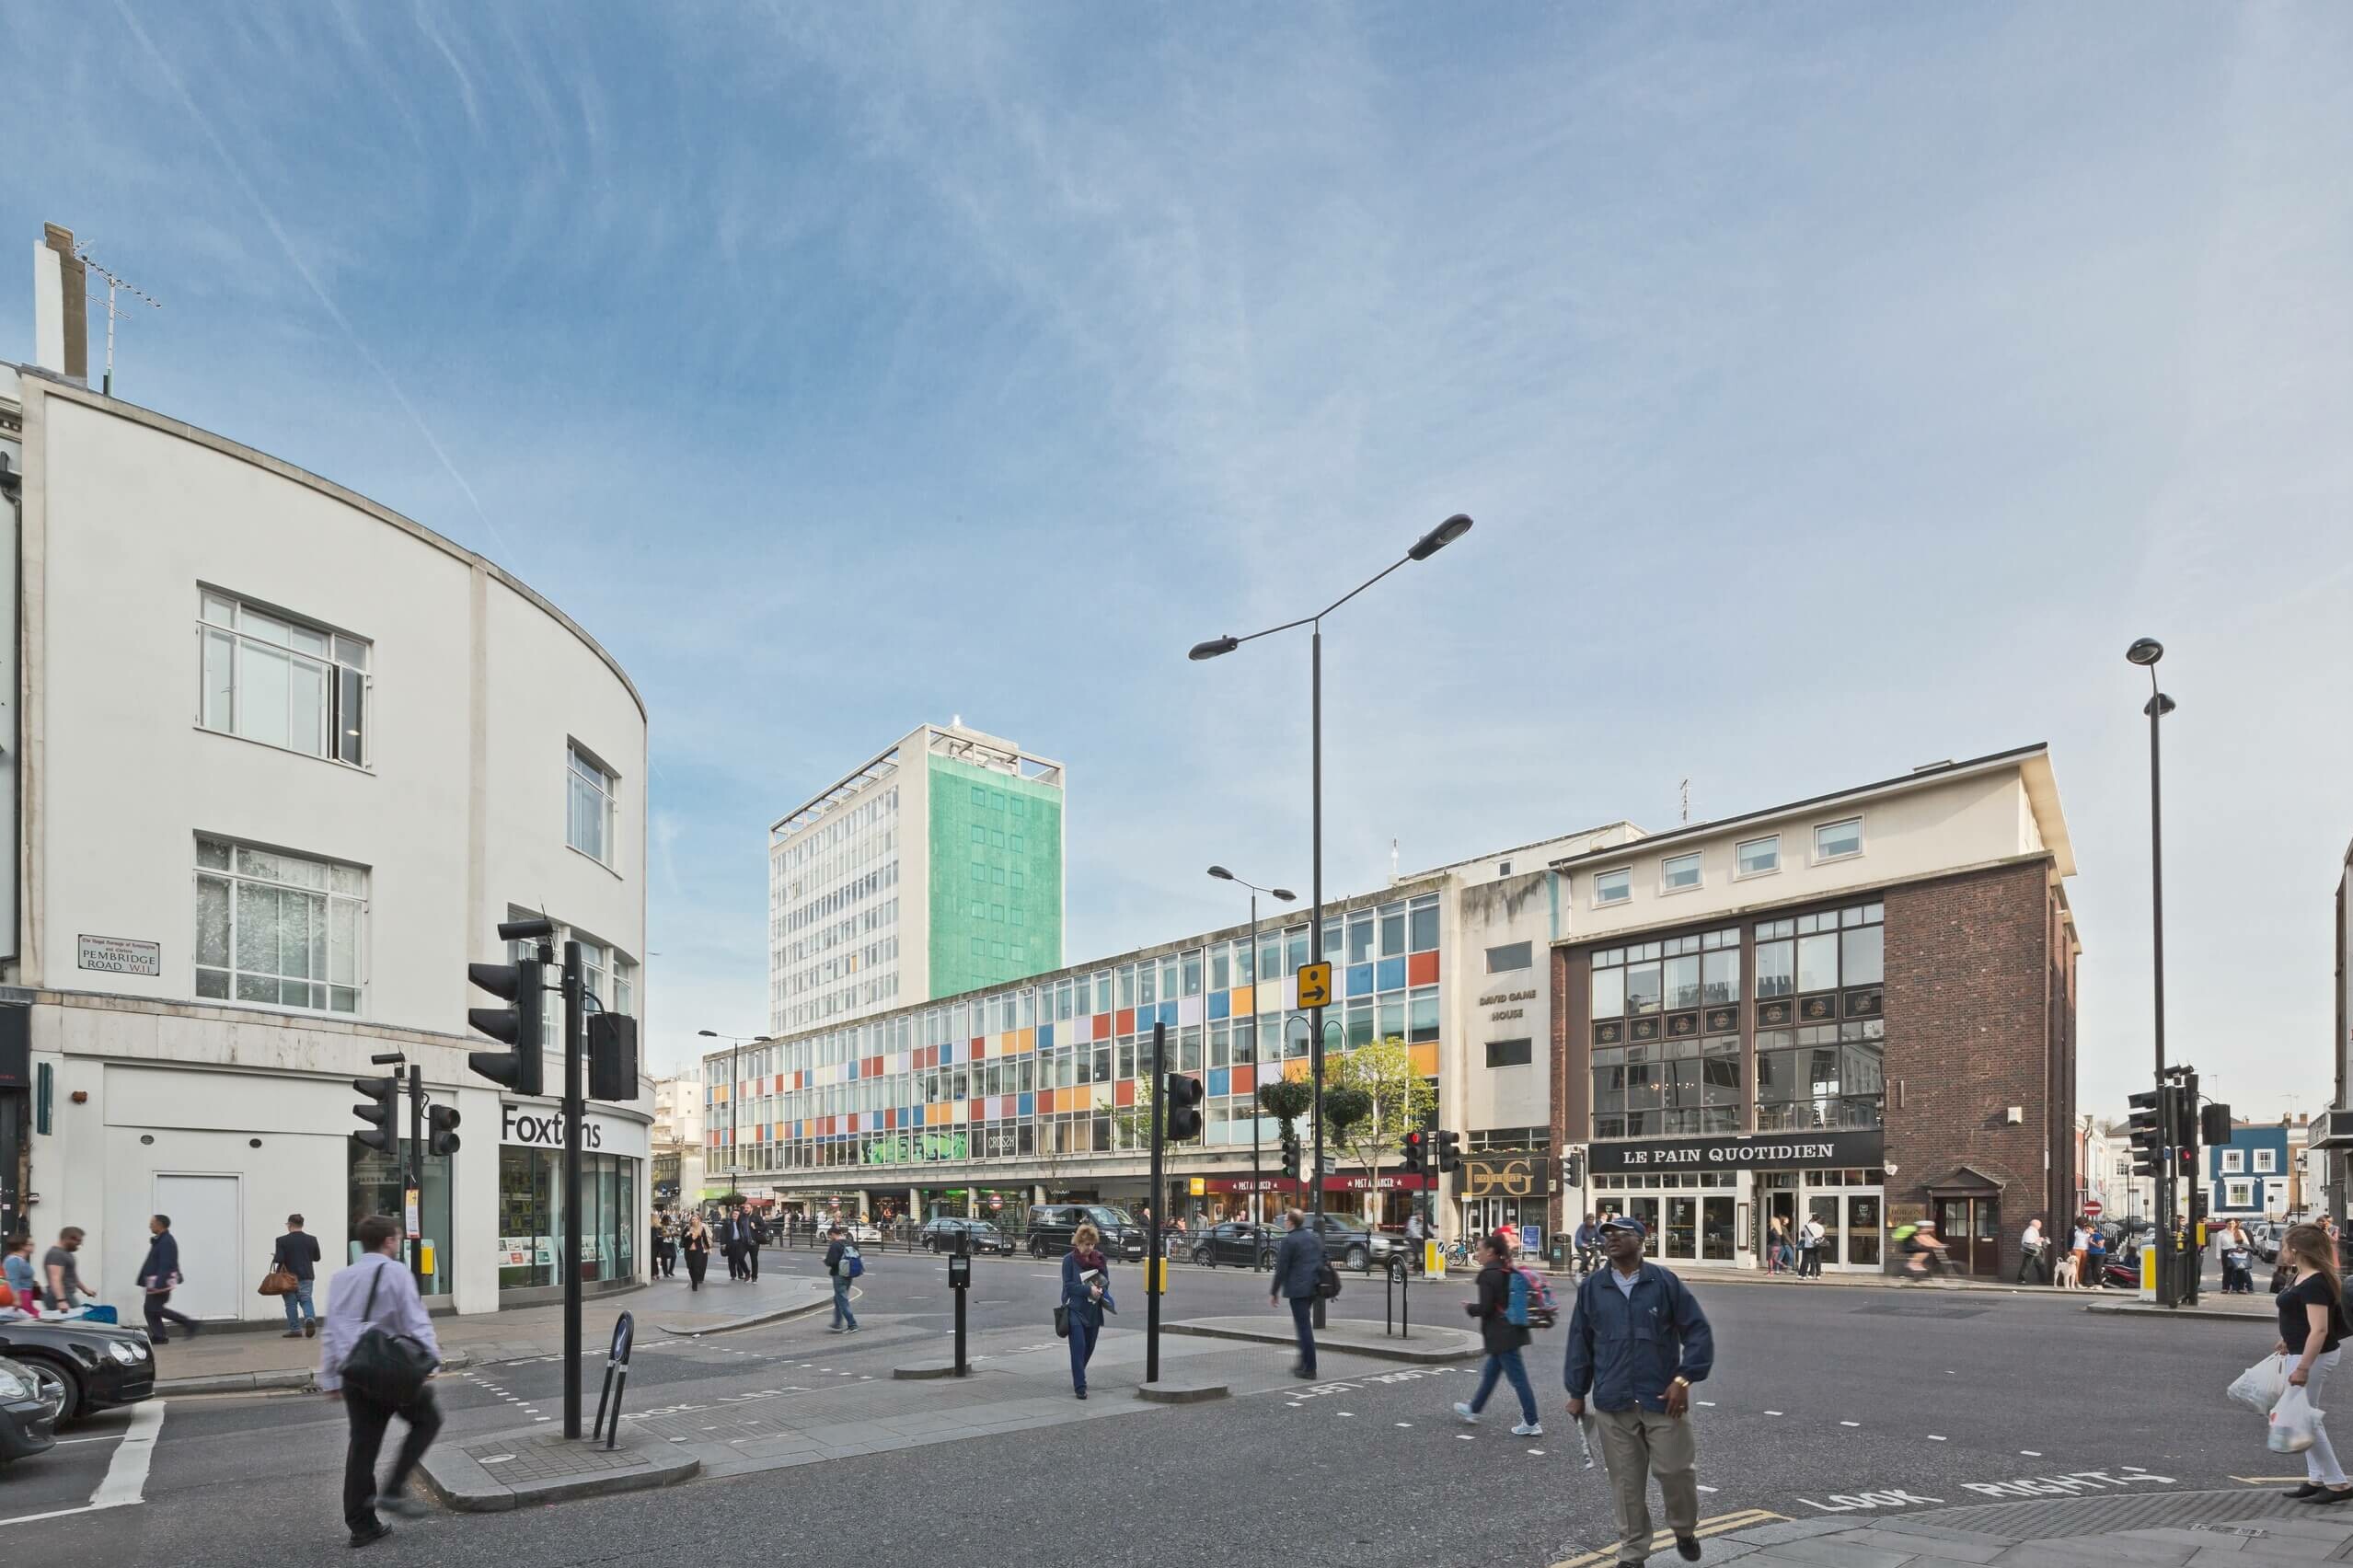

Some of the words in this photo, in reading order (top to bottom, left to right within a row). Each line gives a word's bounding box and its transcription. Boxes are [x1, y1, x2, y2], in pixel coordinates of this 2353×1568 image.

[83, 950, 156, 964] PEMBRIDGE
[1479, 994, 1506, 1007] DAVID
[1508, 989, 1536, 1001] GAME
[1492, 1009, 1523, 1021] HOUSE
[502, 1103, 601, 1148] Foxtns
[1623, 1151, 1647, 1164] LE
[1654, 1148, 1701, 1163] PAIN
[1708, 1144, 1834, 1161] QUOTIDIEN
[618, 1403, 708, 1420] OOK
[1797, 1489, 1944, 1512] LOOK
[1959, 1471, 2129, 1497] RIGHT
